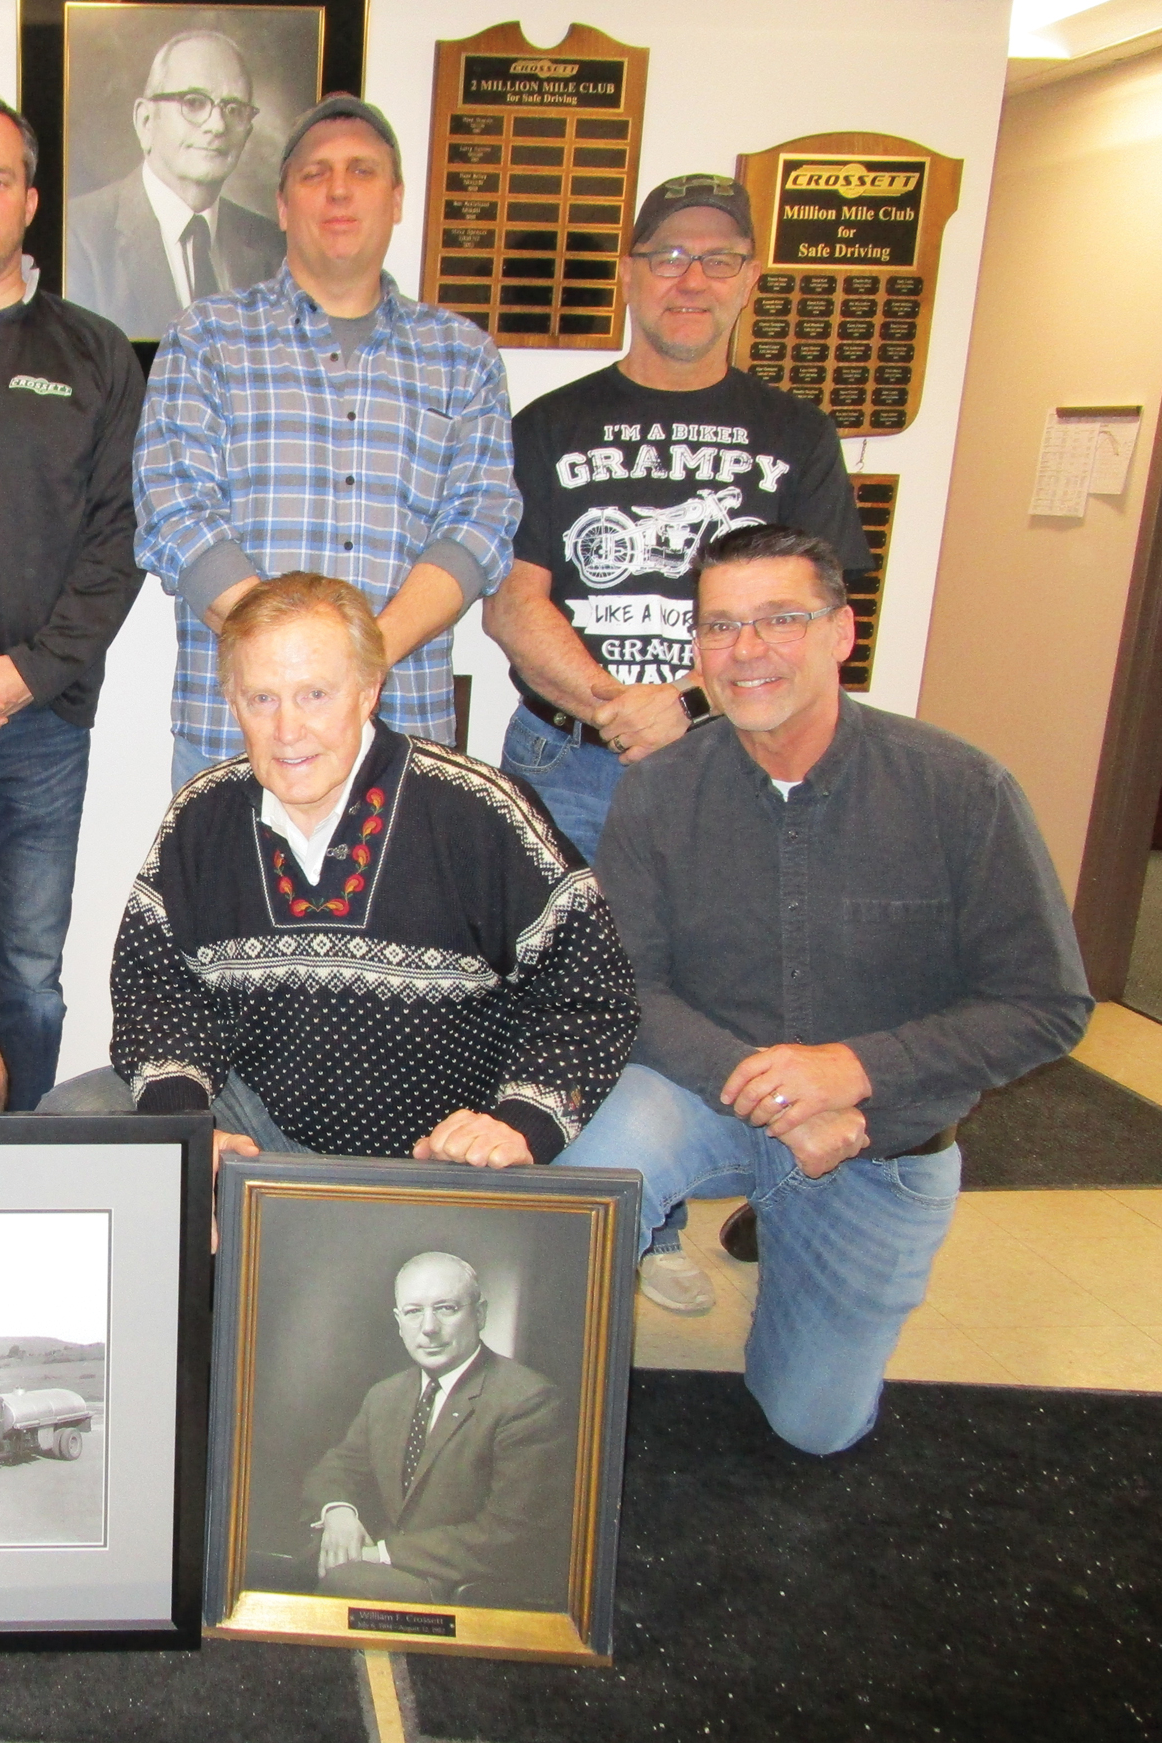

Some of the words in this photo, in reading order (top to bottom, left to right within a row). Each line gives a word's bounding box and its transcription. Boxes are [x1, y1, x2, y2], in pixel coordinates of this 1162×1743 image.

[470, 80, 478, 91] 2
[480, 79, 539, 92] MILLION
[542, 81, 576, 93] MILE
[579, 82, 615, 94] CLUB
[506, 93, 520, 102] for
[522, 93, 540, 103] Safe
[543, 94, 577, 105] Driving
[791, 173, 916, 188] CROSSETT
[783, 205, 837, 220] Million
[841, 206, 875, 221] Mile
[879, 206, 915, 221] Club
[838, 226, 857, 238] for
[798, 243, 830, 258] Safe
[834, 243, 891, 261] Driving
[11, 379, 72, 394] CROSSETT
[603, 423, 642, 441] I'M
[647, 423, 666, 441] A
[671, 423, 749, 445] BIKER
[556, 444, 790, 493] GRAMPY
[595, 604, 634, 623] LIKE
[641, 604, 651, 623] A
[359, 1611, 393, 1621] William
[406, 1615, 443, 1625] Crossett
